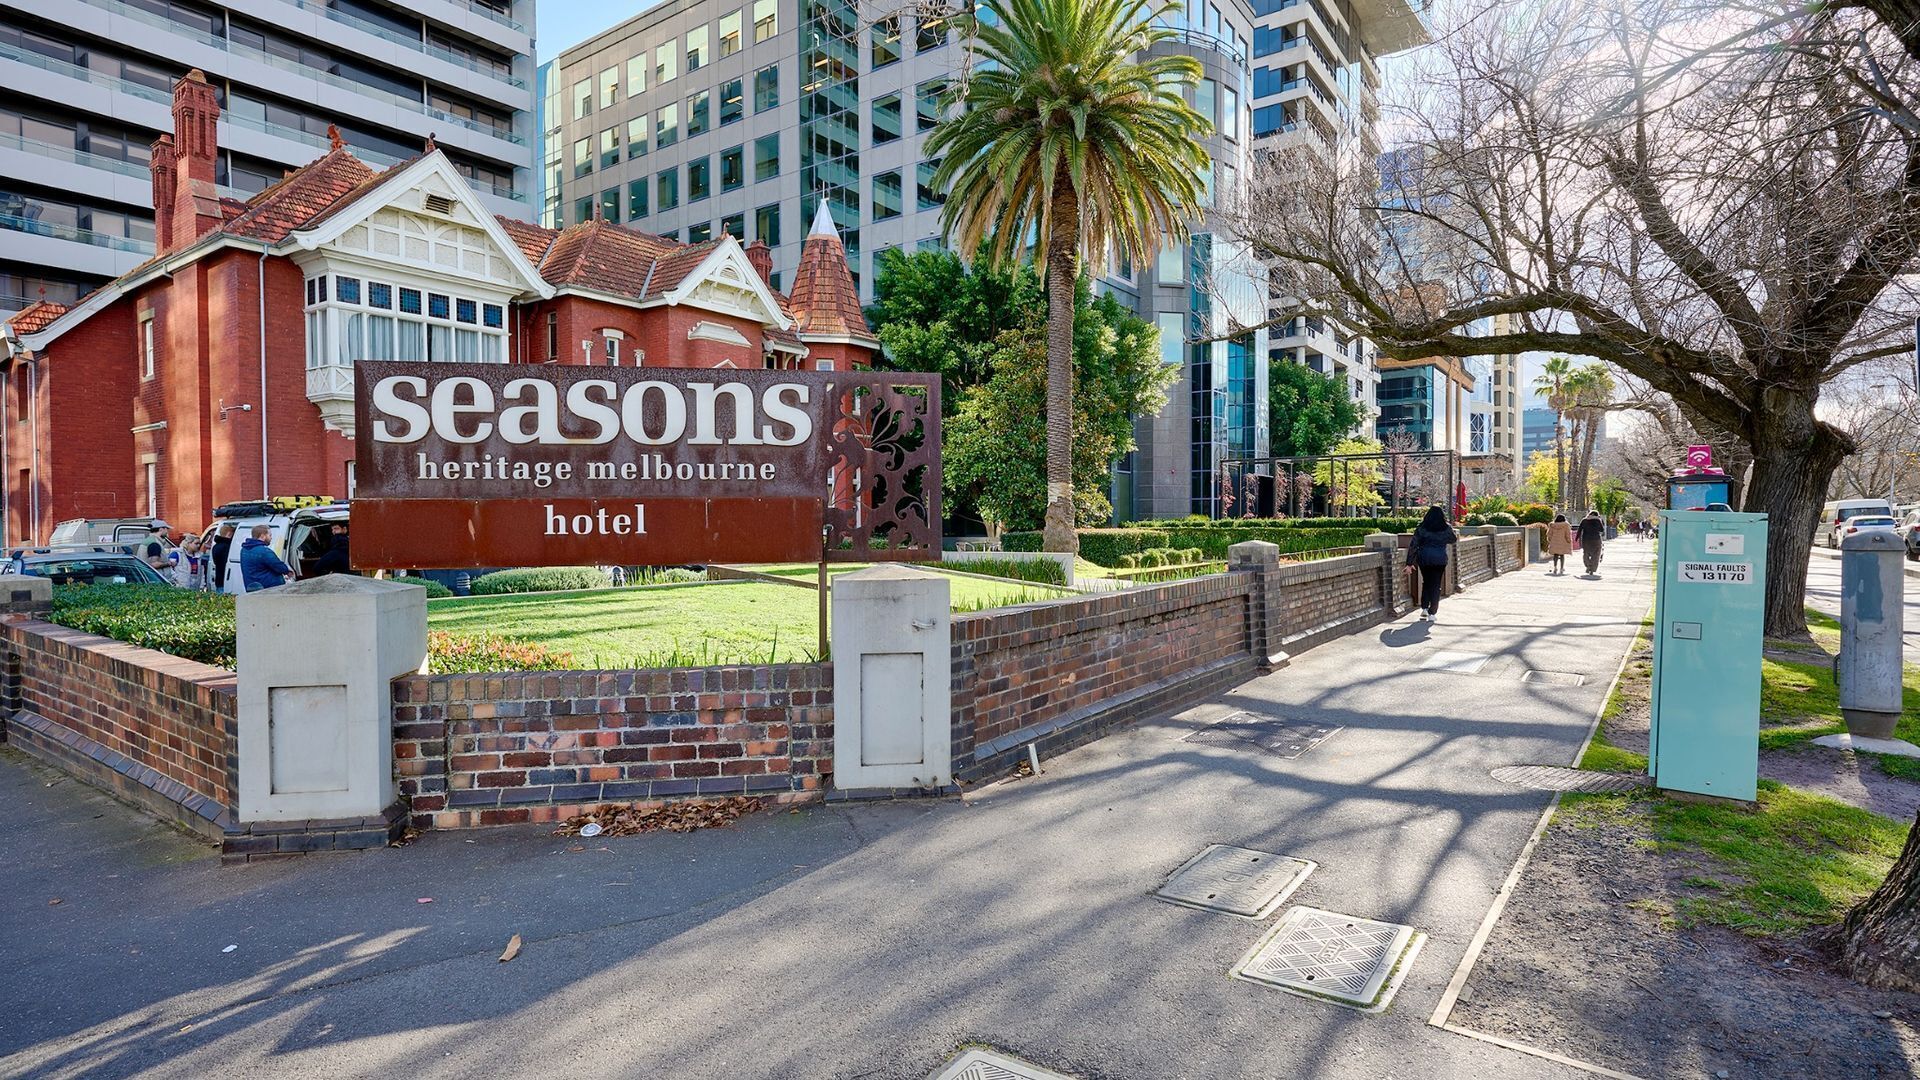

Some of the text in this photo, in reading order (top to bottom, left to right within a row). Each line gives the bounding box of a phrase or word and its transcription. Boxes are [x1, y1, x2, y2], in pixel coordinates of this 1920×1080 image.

[372, 375, 812, 446] seasons
[416, 452, 776, 488] heritage melbourne
[543, 503, 647, 535] hotel
[1685, 563, 1746, 572] SIGNAL FAULTS
[1702, 572, 1745, 581] 13 11 70
